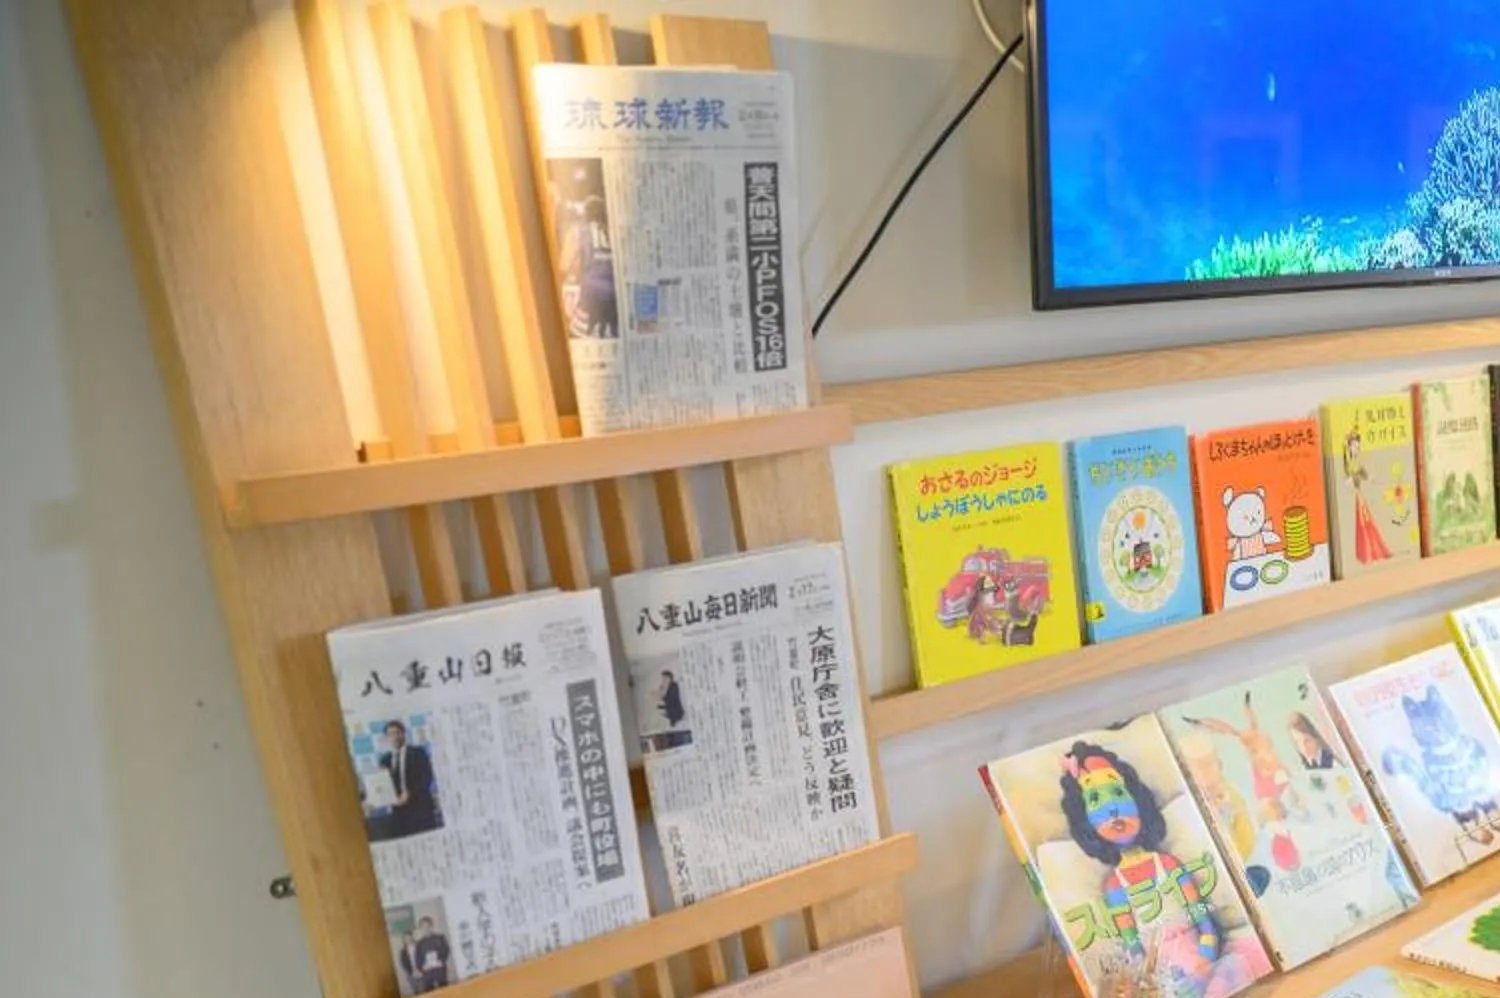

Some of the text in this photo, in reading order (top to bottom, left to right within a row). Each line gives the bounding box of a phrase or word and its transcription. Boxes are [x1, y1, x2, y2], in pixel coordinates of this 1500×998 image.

[563, 97, 729, 131] 琉球新報
[919, 457, 1038, 496] おさるのジョージ
[916, 484, 1049, 523] しょうぼうしゃにのる
[637, 583, 779, 635] 八重山毎日新聞
[360, 642, 529, 698] 八重山日報
[807, 625, 858, 813] 大原庁舎に歓迎と疑問
